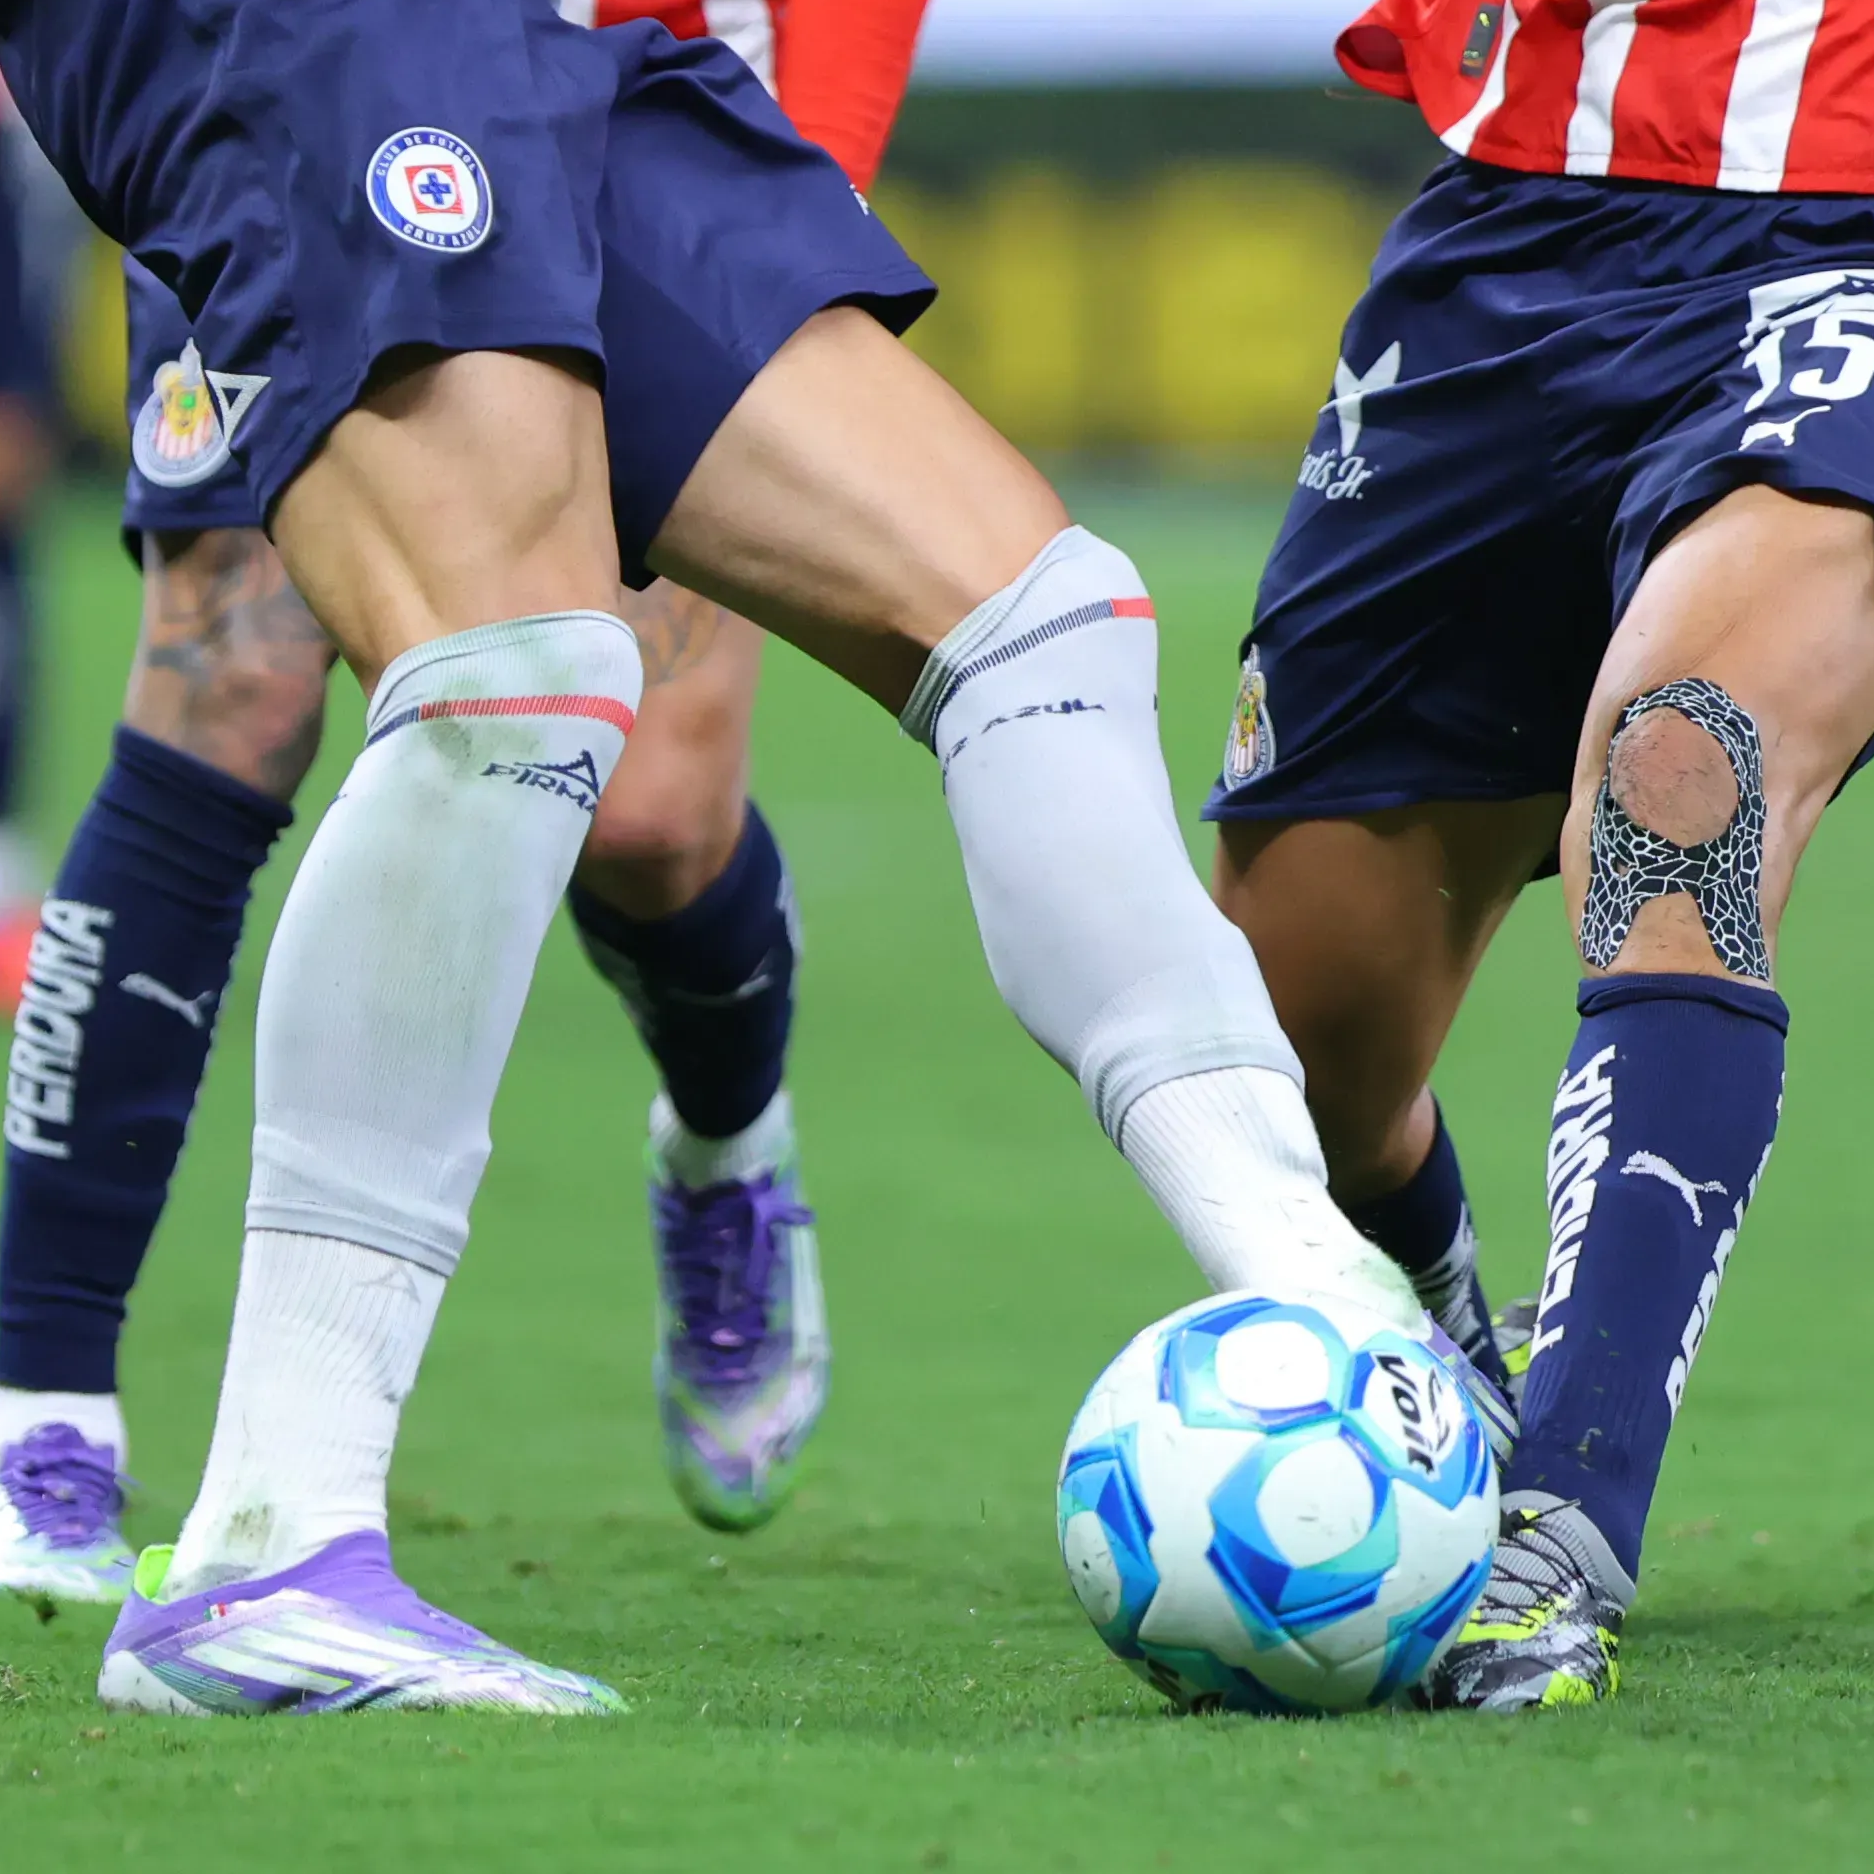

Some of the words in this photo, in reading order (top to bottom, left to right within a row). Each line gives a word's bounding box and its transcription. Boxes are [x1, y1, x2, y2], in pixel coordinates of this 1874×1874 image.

[376, 145, 401, 177] CLUB
[404, 134, 423, 146] DE
[429, 134, 477, 172] FUTBOL
[402, 223, 447, 246] CRUZ
[451, 226, 482, 247] AZUL
[1326, 456, 1374, 500] Jr.
